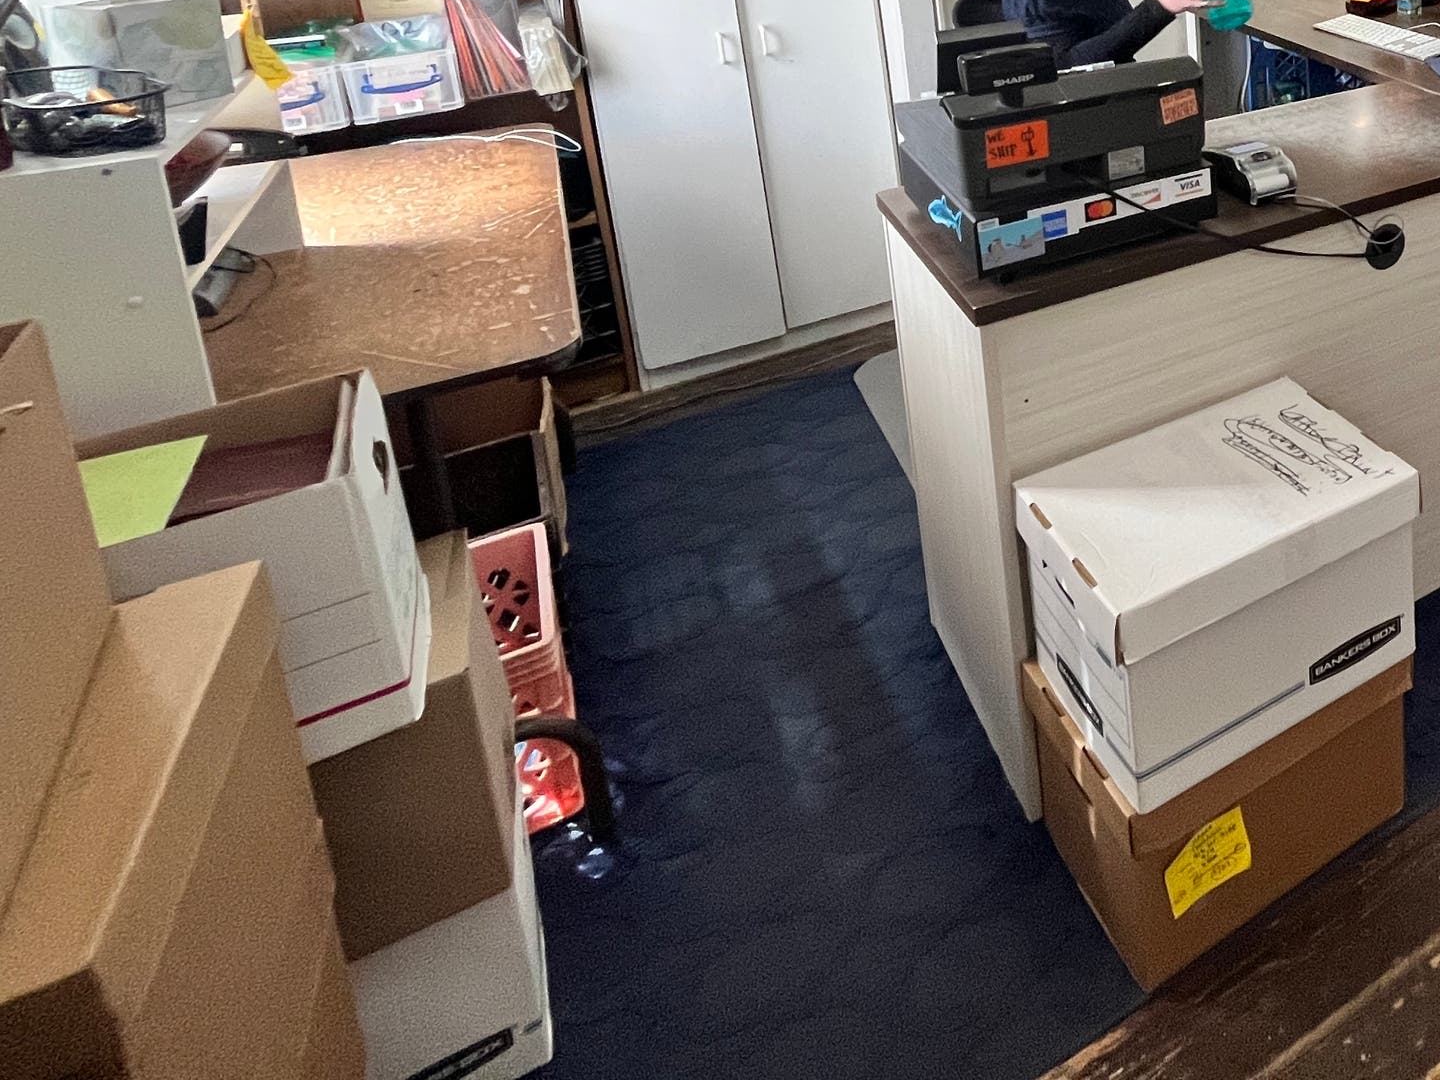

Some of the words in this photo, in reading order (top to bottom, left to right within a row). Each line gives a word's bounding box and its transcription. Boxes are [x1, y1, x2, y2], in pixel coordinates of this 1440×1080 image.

[993, 73, 1035, 88] SHARP
[987, 129, 1006, 144] WE
[988, 143, 1018, 161] SHIP
[1179, 179, 1201, 191] VISA
[1315, 638, 1371, 676] BANKERS
[1372, 624, 1396, 643] BOX
